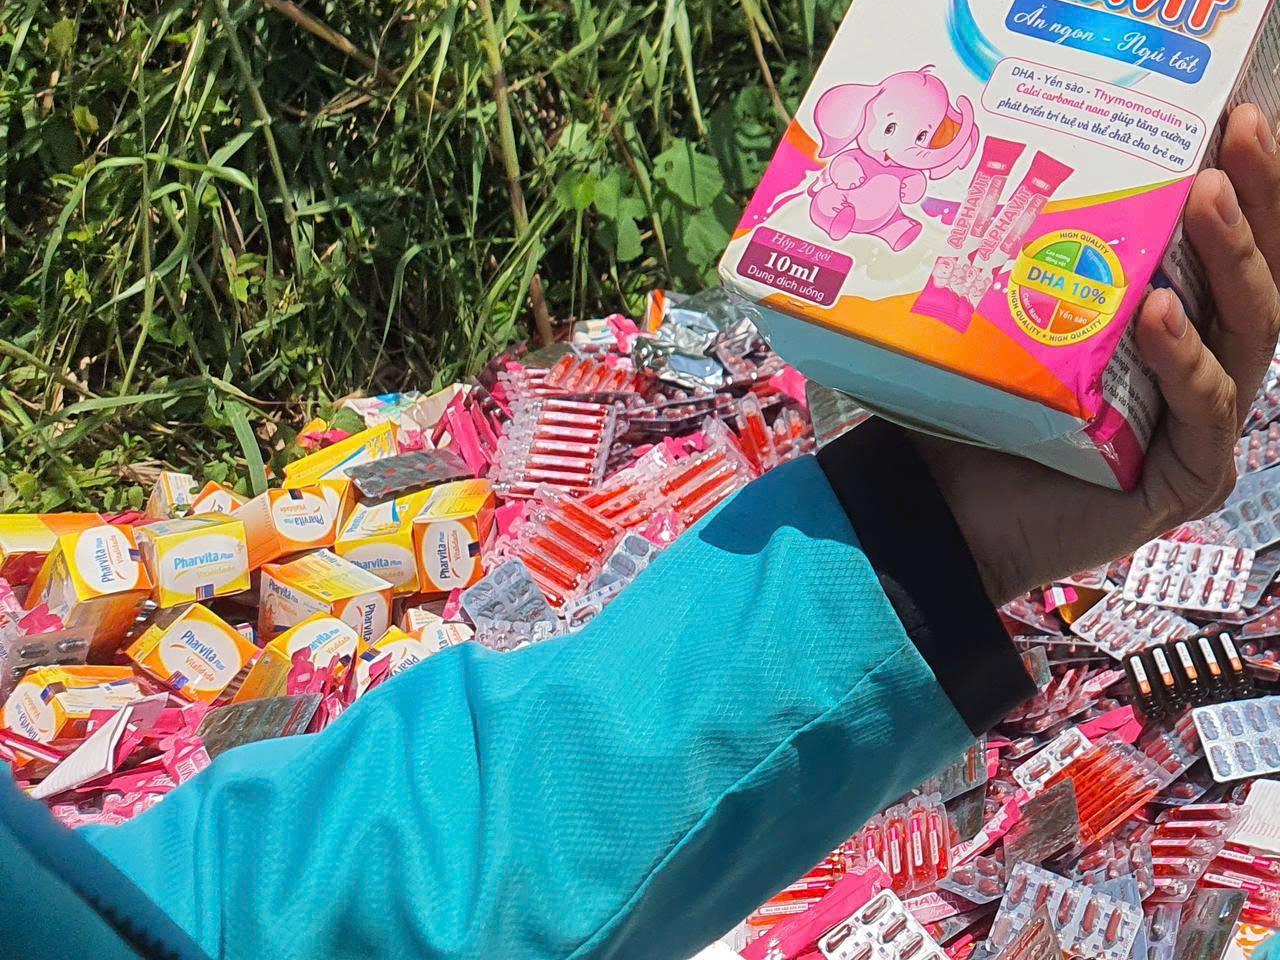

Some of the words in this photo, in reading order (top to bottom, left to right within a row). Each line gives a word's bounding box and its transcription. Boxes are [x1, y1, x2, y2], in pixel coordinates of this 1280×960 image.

[1013, 3, 1048, 30] Ăn
[1050, 21, 1096, 45] ngon
[1116, 31, 1167, 68] Ngủ
[1167, 49, 1200, 74] tốt
[1011, 66, 1035, 81] DHA
[1043, 74, 1063, 89] Yến
[1064, 80, 1084, 94] sào
[1093, 87, 1184, 128] Thymomodulin
[1185, 120, 1198, 135] và
[1016, 82, 1041, 98] Calci
[1041, 91, 1085, 111] carbonat
[1085, 104, 1111, 119] nano
[1111, 111, 1135, 126] giúp
[1135, 117, 1159, 137] tăng
[1160, 128, 1192, 151] cường
[997, 97, 1021, 113] phát
[1022, 102, 1046, 120] triển
[1046, 108, 1060, 122] trí
[1060, 112, 1078, 127] tuệ
[1077, 119, 1089, 130] và
[1090, 121, 1109, 136] thể
[1108, 126, 1131, 144] chất
[1132, 134, 1151, 152] cho
[1152, 143, 1169, 159] trẻ
[1169, 152, 1185, 166] em
[947, 171, 989, 251] ALPHAVIT
[979, 186, 1032, 261] ALPHAVIT
[797, 242, 816, 255] 20
[1080, 234, 1110, 255] QUALITY
[747, 264, 776, 284] Dung
[776, 275, 798, 290] dịch
[798, 285, 826, 302] uống
[764, 251, 820, 283] 10ml
[1026, 266, 1066, 290] DHA
[1071, 281, 1106, 305] 10%
[1010, 289, 1018, 307] HIGH
[1015, 310, 1041, 336] QUALITY
[1069, 318, 1103, 340] QUALITY
[293, 514, 325, 527] Pharvita
[95, 546, 115, 584] Pharvita
[173, 551, 219, 571] Pharvita
[438, 543, 450, 580] Pharvita
[268, 578, 292, 600] Pharvita
[181, 629, 217, 665] Pharvita
[184, 655, 217, 684] Vitalidade
